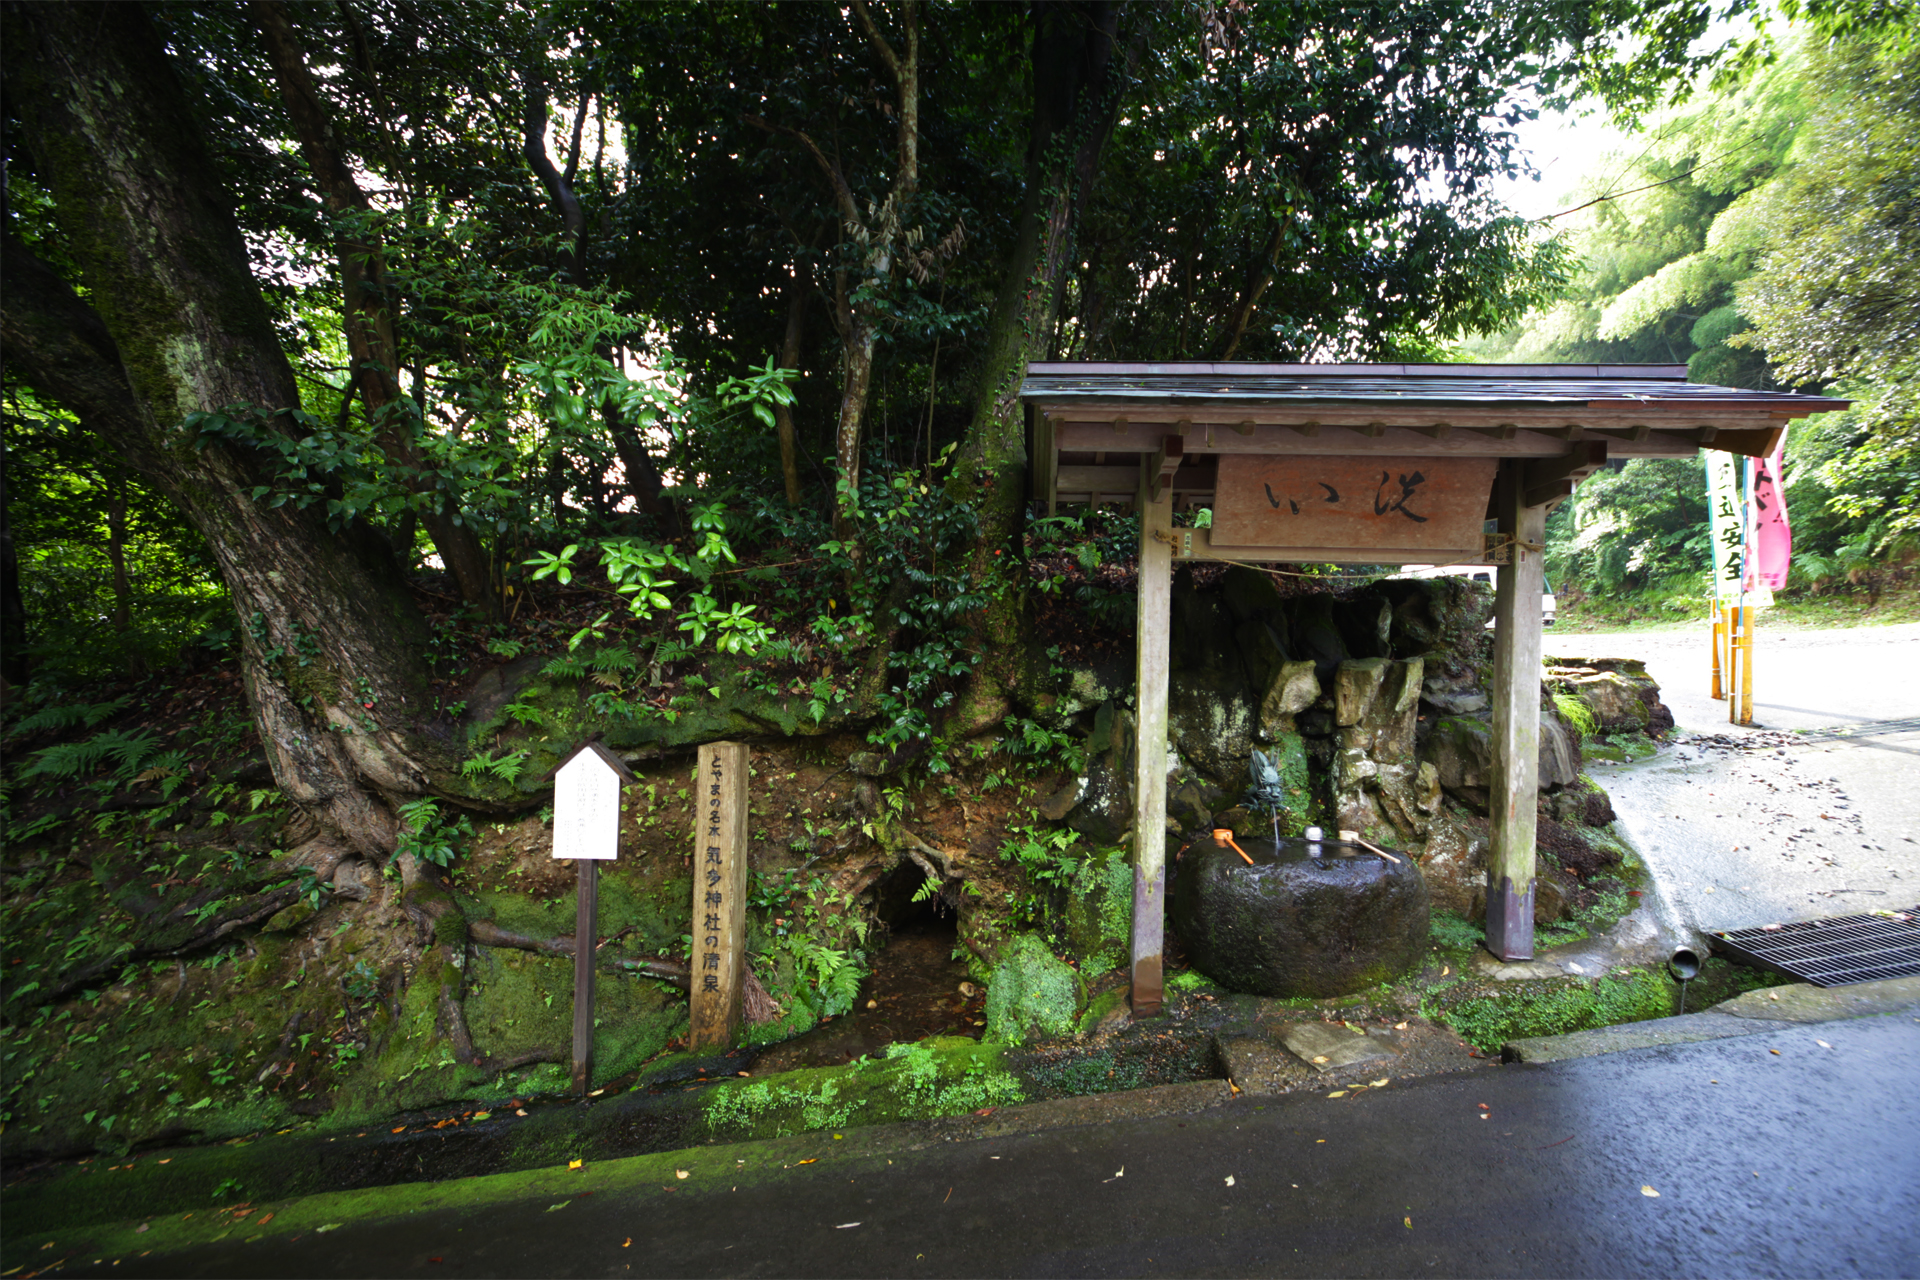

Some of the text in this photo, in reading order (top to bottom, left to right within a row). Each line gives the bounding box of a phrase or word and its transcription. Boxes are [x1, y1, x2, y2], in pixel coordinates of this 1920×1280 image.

[709, 756, 722, 837] とやまの名水
[702, 846, 722, 992] 気多神社の清泉
